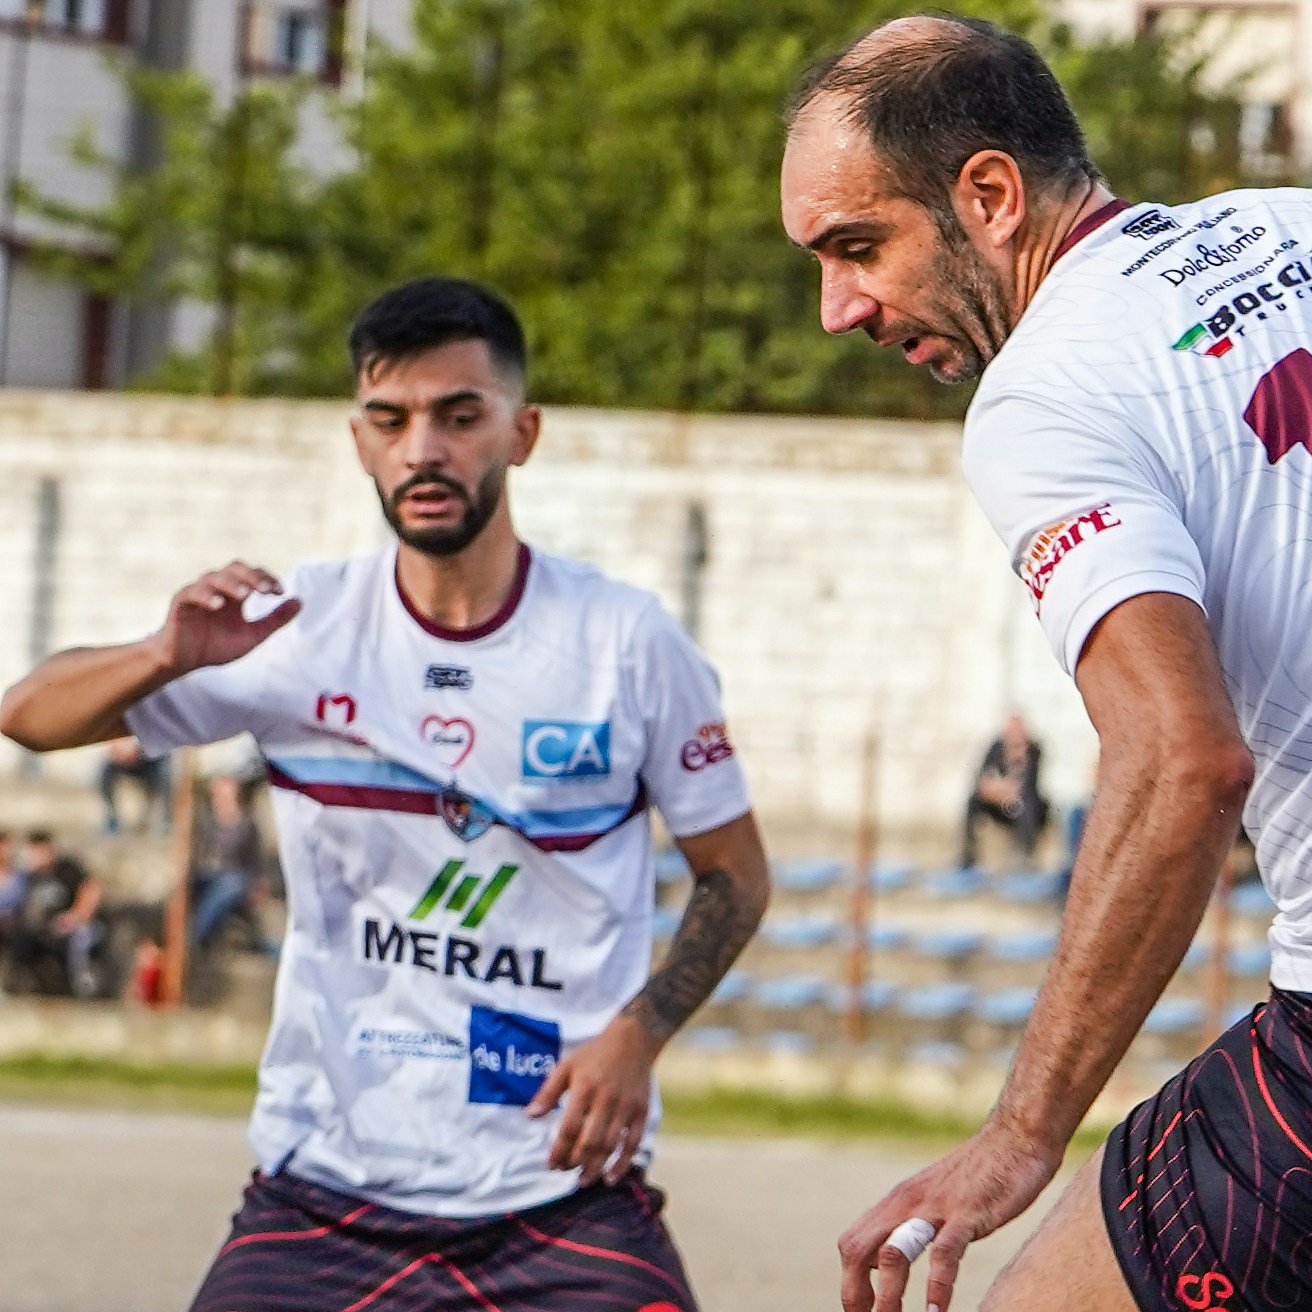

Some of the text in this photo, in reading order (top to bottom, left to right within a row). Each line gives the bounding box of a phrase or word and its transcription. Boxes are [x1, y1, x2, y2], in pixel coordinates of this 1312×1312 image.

[526, 725, 604, 776] CA
[364, 917, 564, 991] MERAL
[473, 1043, 501, 1073] de
